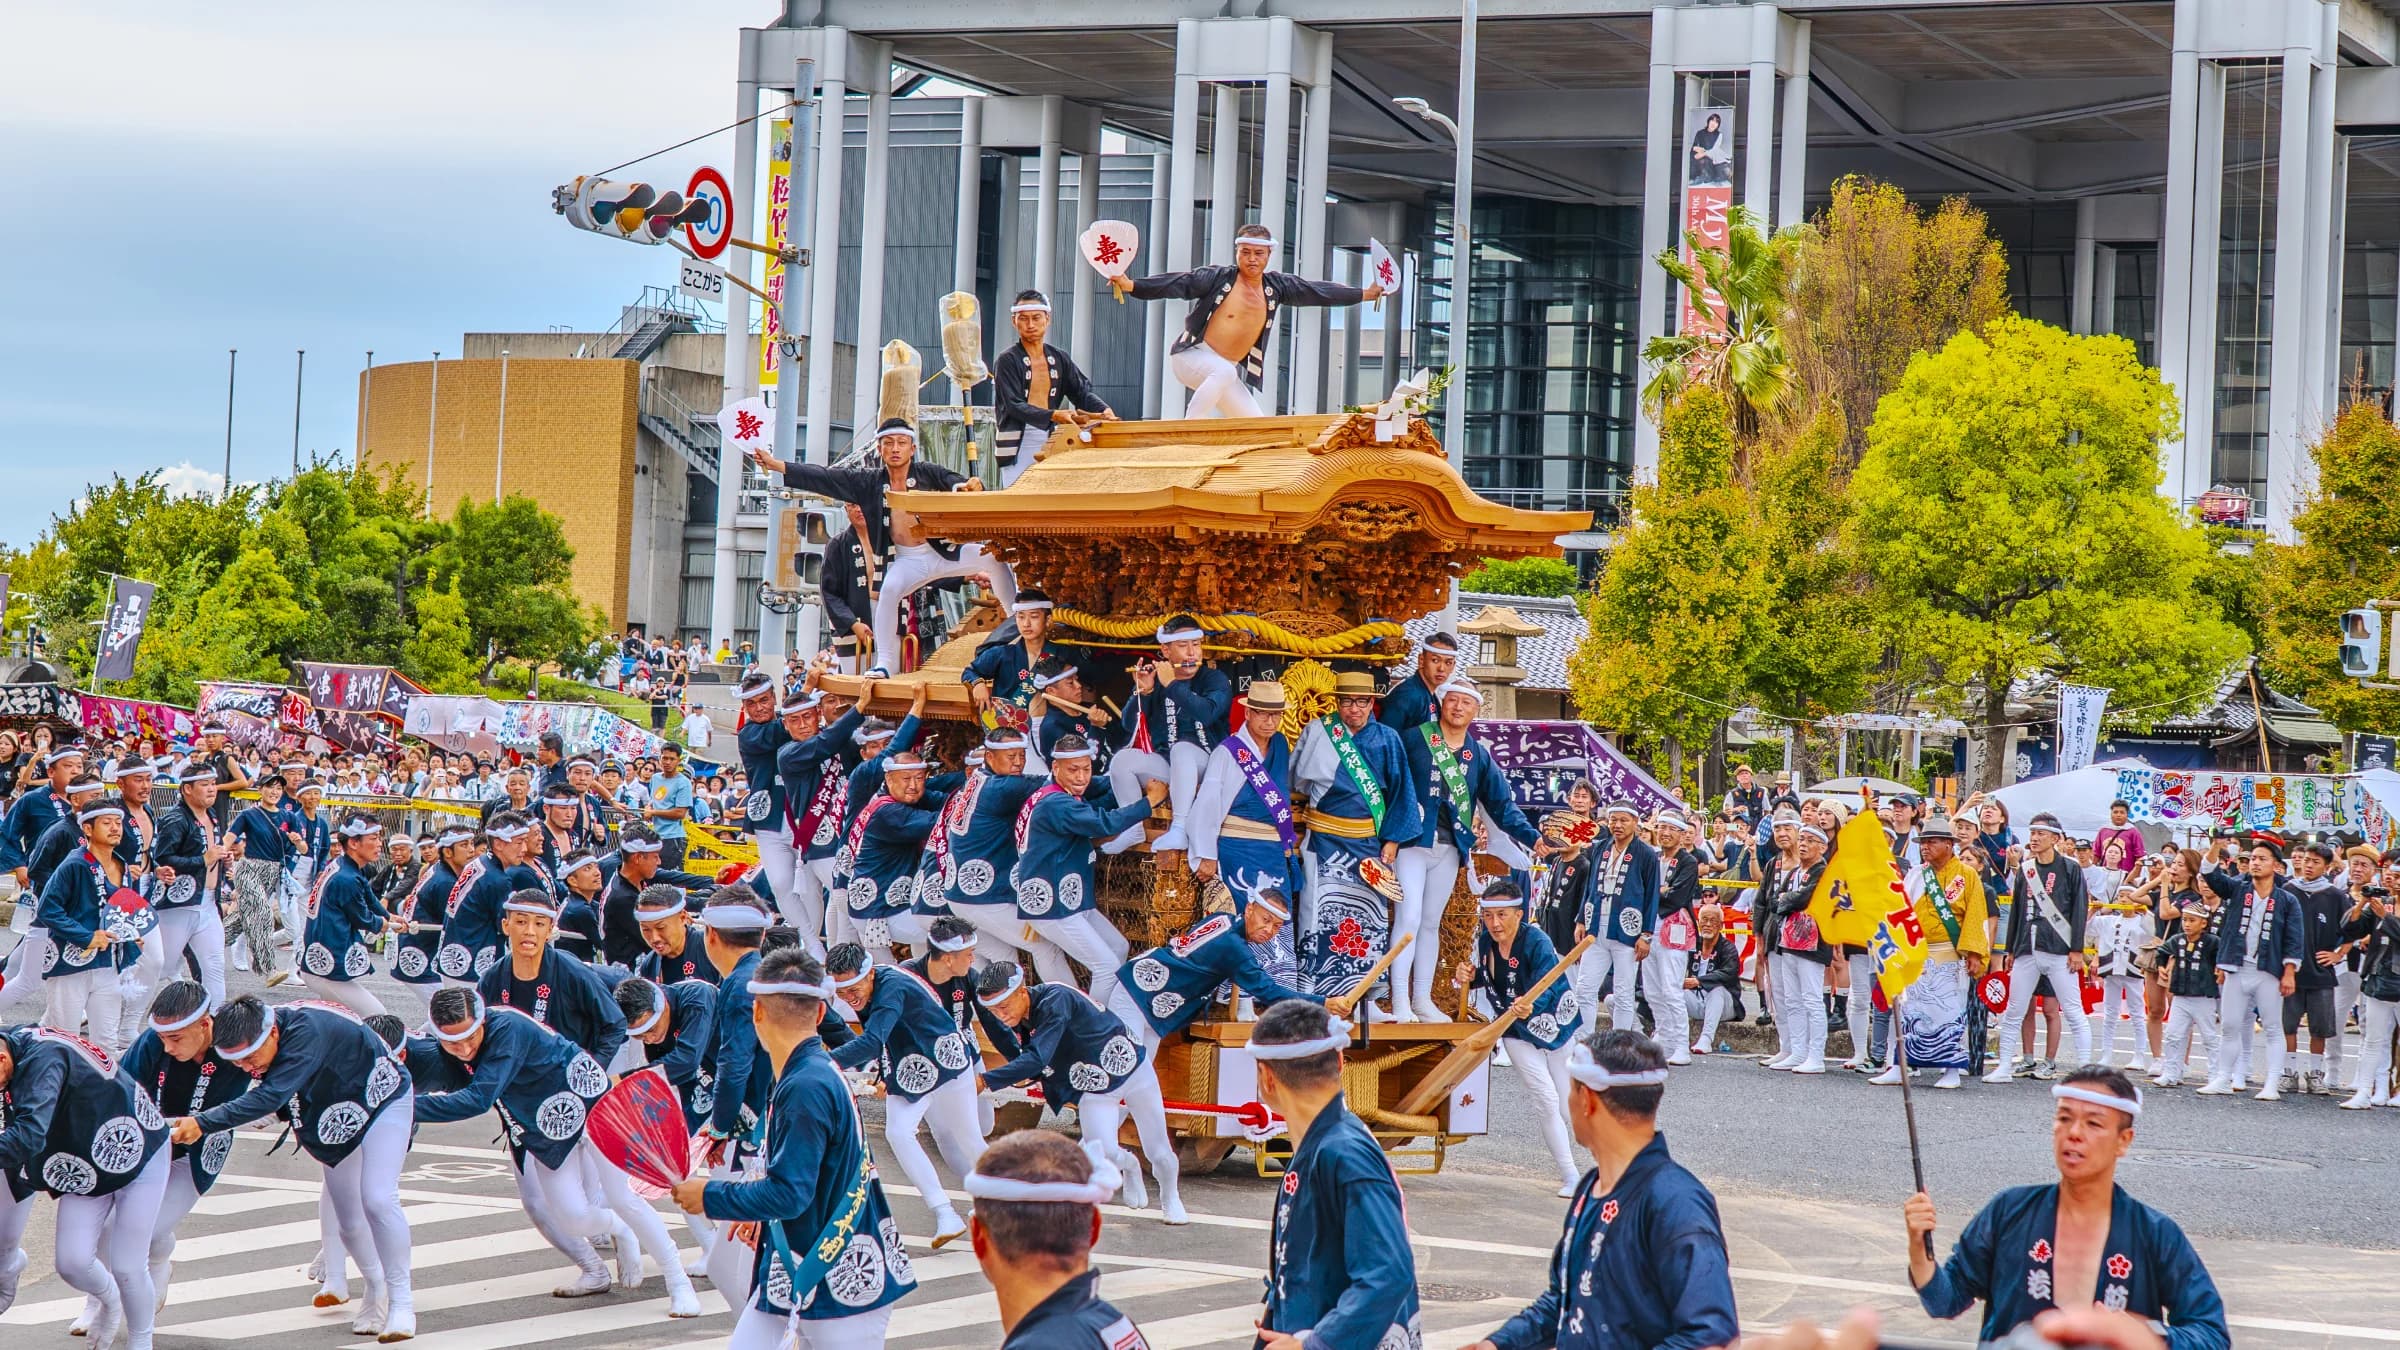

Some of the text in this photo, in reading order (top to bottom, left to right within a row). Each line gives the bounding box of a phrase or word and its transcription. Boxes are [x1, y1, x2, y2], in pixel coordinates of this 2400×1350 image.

[682, 267, 722, 293] ここから
[1252, 770, 1291, 824] 相談役
[1435, 747, 1470, 813] 副責任者
